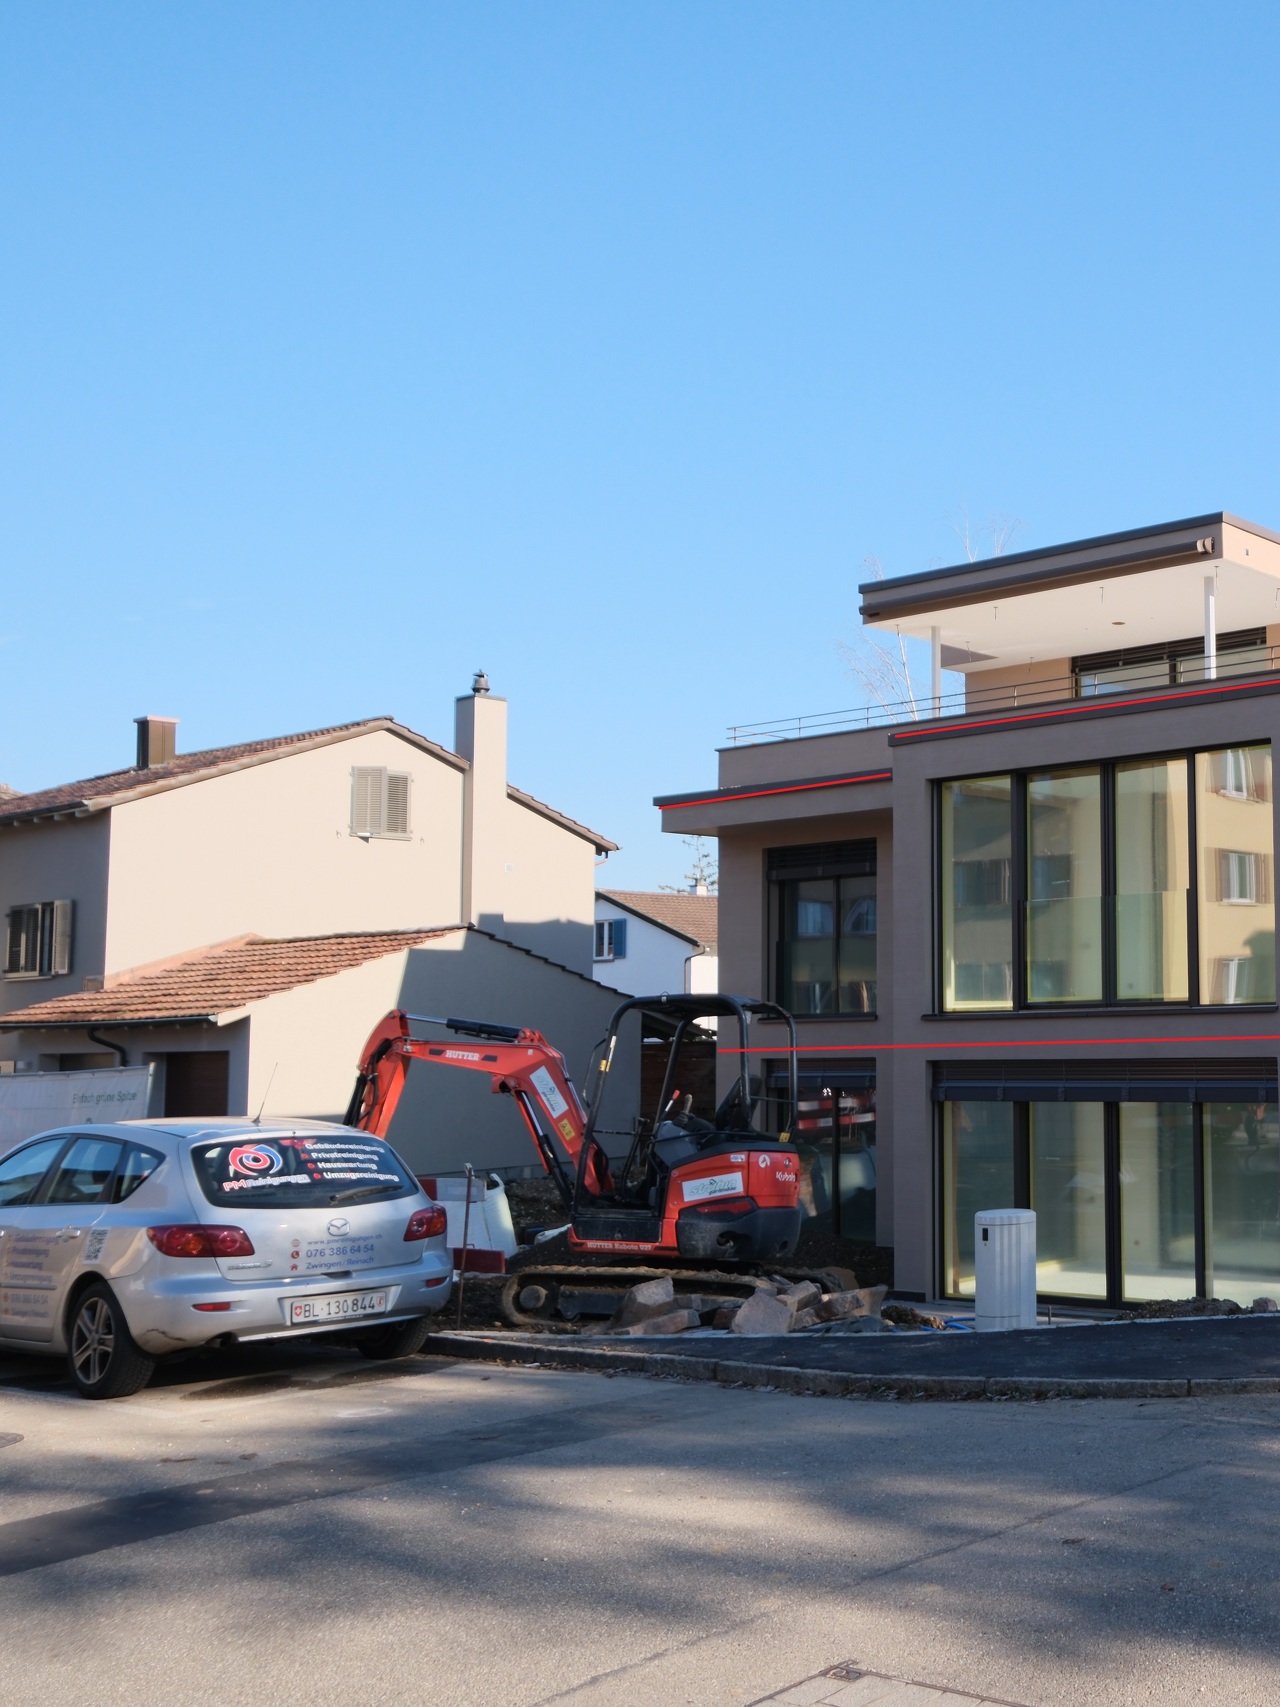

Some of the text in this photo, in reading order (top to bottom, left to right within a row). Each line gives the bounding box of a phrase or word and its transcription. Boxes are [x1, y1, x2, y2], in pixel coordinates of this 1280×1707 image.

[445, 1050, 480, 1061] HUTTER
[311, 1152, 379, 1161] Privatreinigung
[317, 1162, 378, 1170] Hauswartung
[306, 1244, 374, 1258] 076 386 64 54
